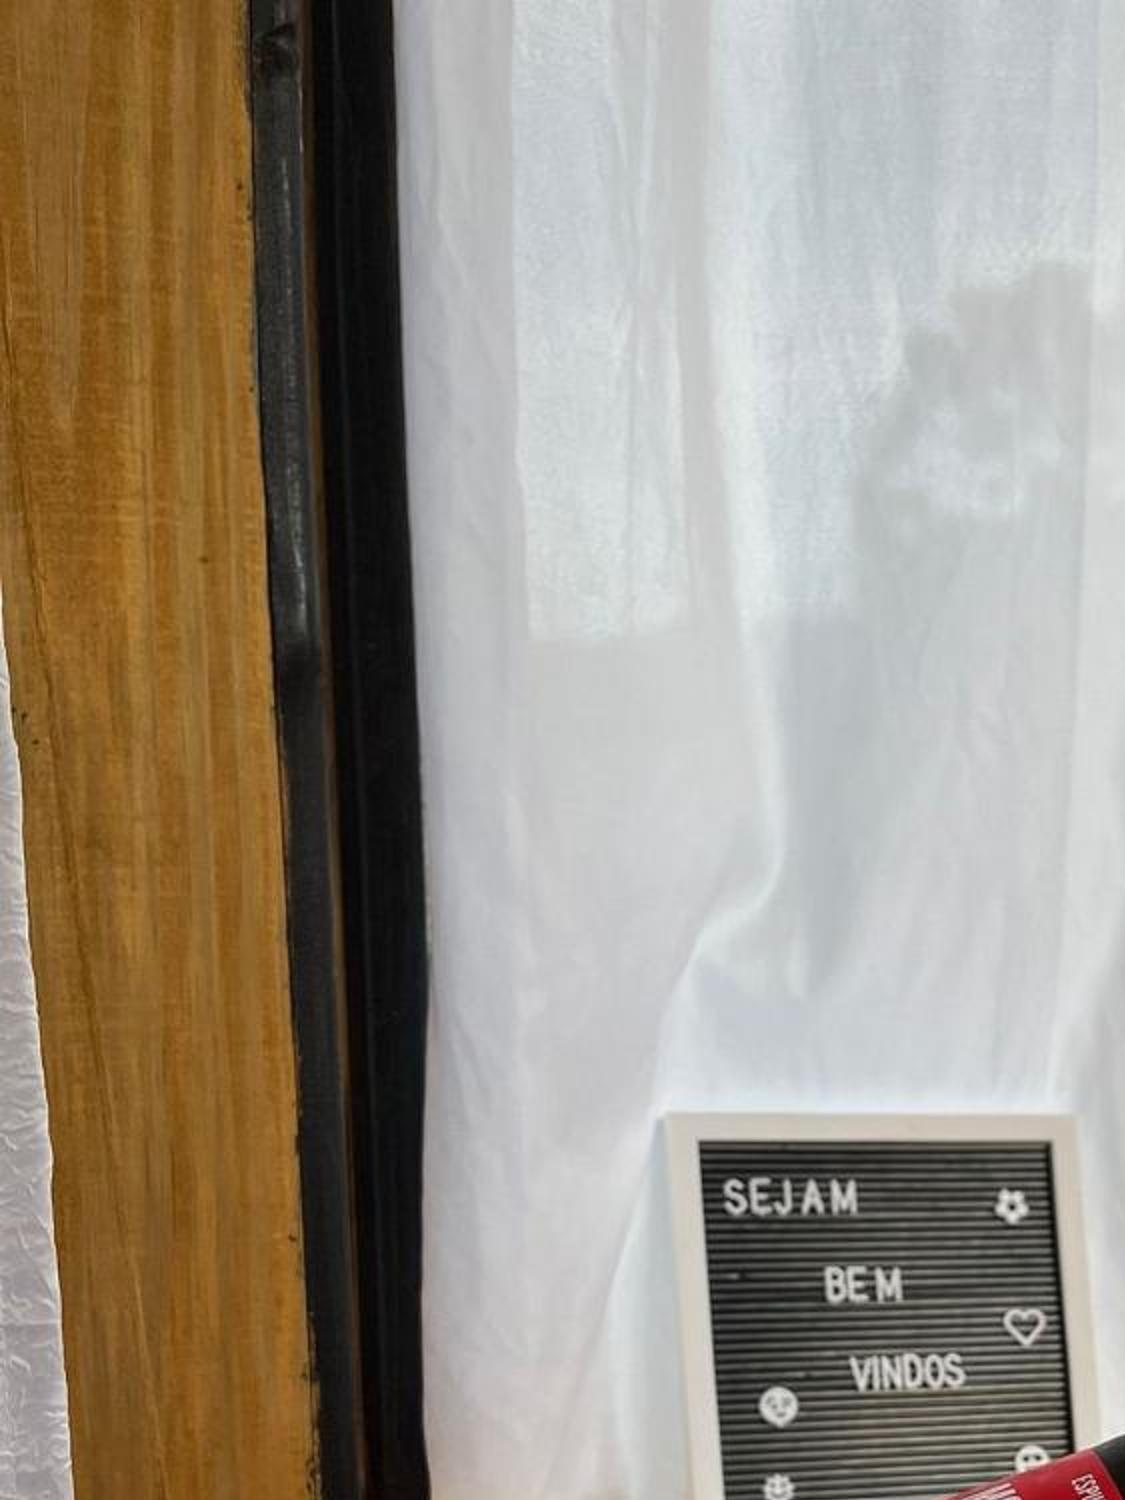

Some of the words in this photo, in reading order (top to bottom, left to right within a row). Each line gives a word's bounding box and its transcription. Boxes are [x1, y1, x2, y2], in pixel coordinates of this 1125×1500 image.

[722, 1176, 859, 1217] SEJAM
[823, 1264, 904, 1305] BEM
[848, 1351, 967, 1392] VINDOS
